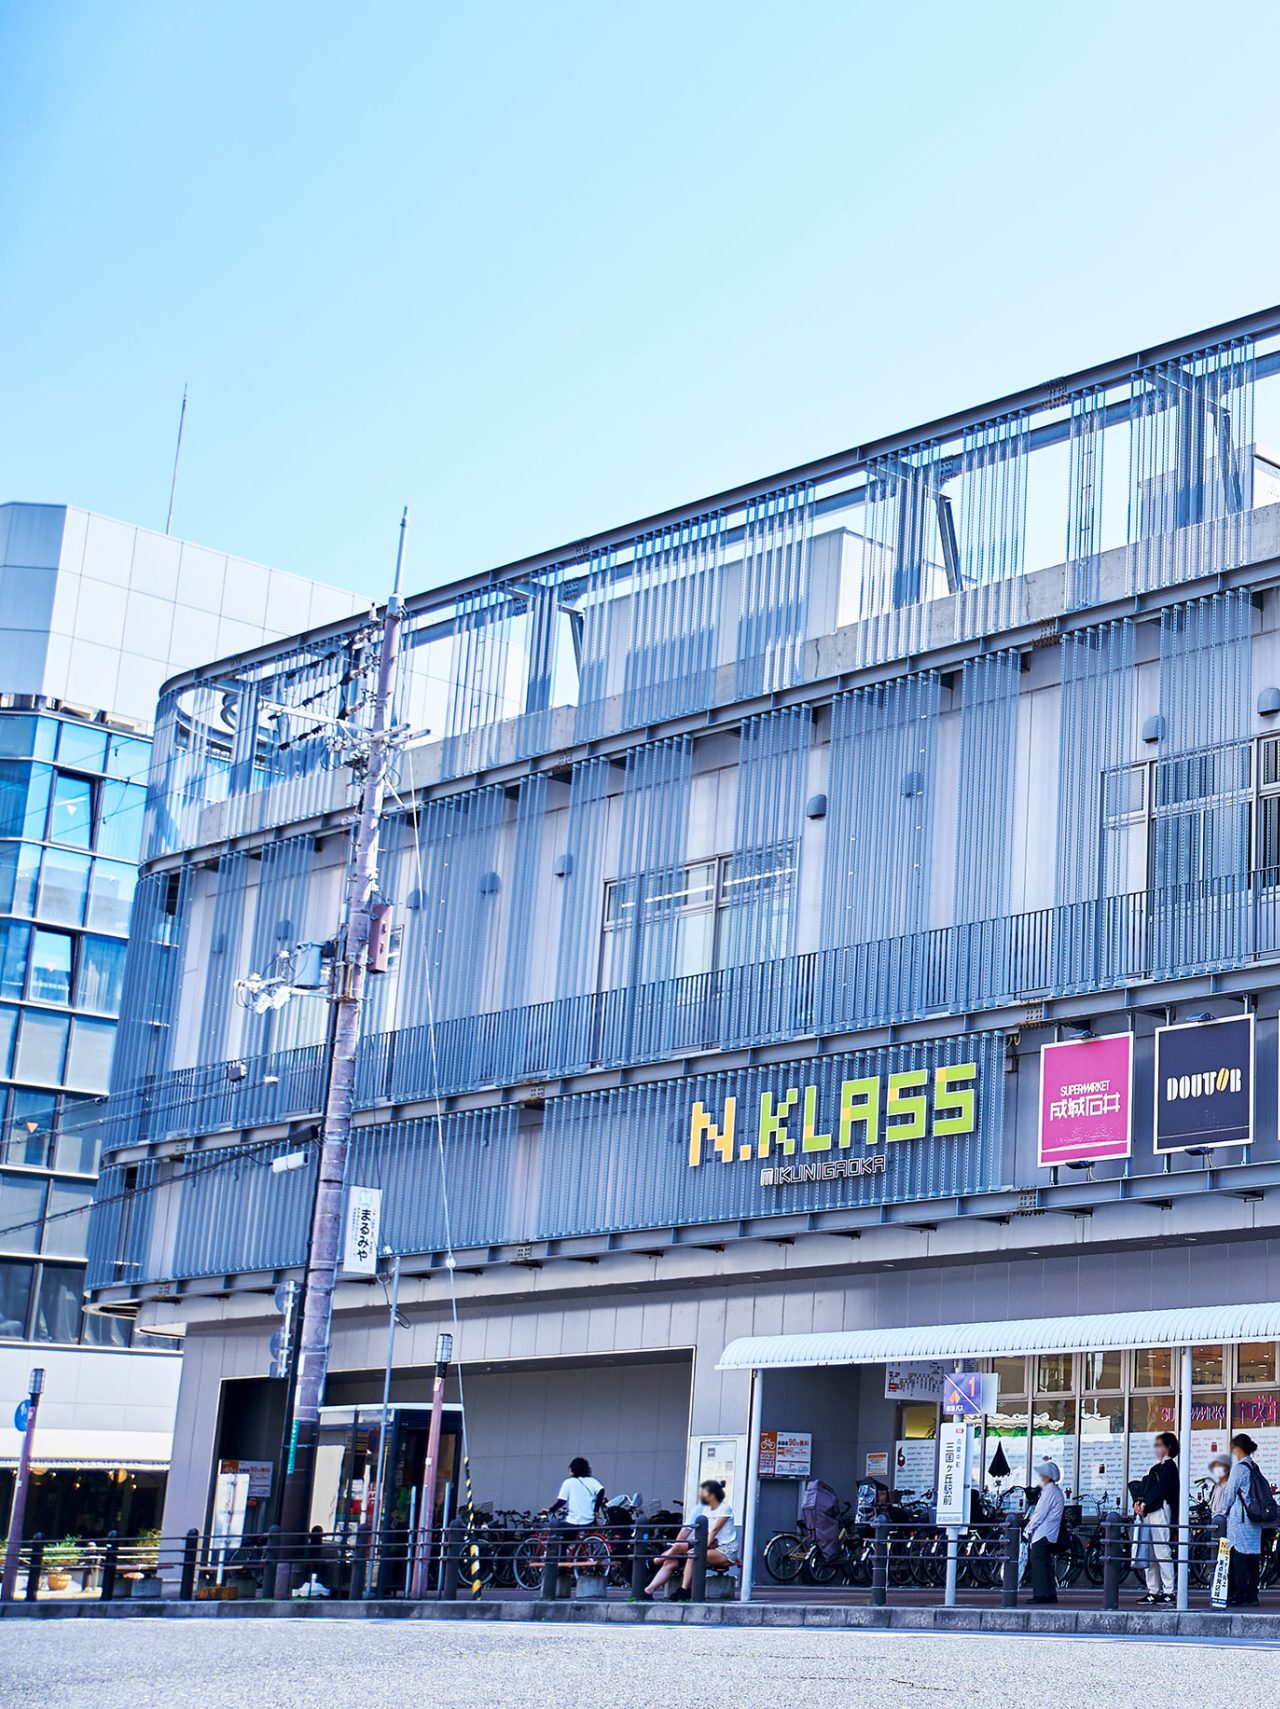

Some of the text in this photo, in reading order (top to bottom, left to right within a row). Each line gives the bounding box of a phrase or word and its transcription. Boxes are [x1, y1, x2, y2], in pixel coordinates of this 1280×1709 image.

[1060, 1080, 1110, 1097] SUPERMARKET
[1166, 1067, 1242, 1101] DOUTOR
[689, 1062, 976, 1167] N.KLASS
[1049, 1092, 1121, 1122] 成城石井
[760, 1155, 886, 1186] MIKUNIGAOKA
[357, 1209, 371, 1262] まるみや
[969, 1376, 976, 1397] 1
